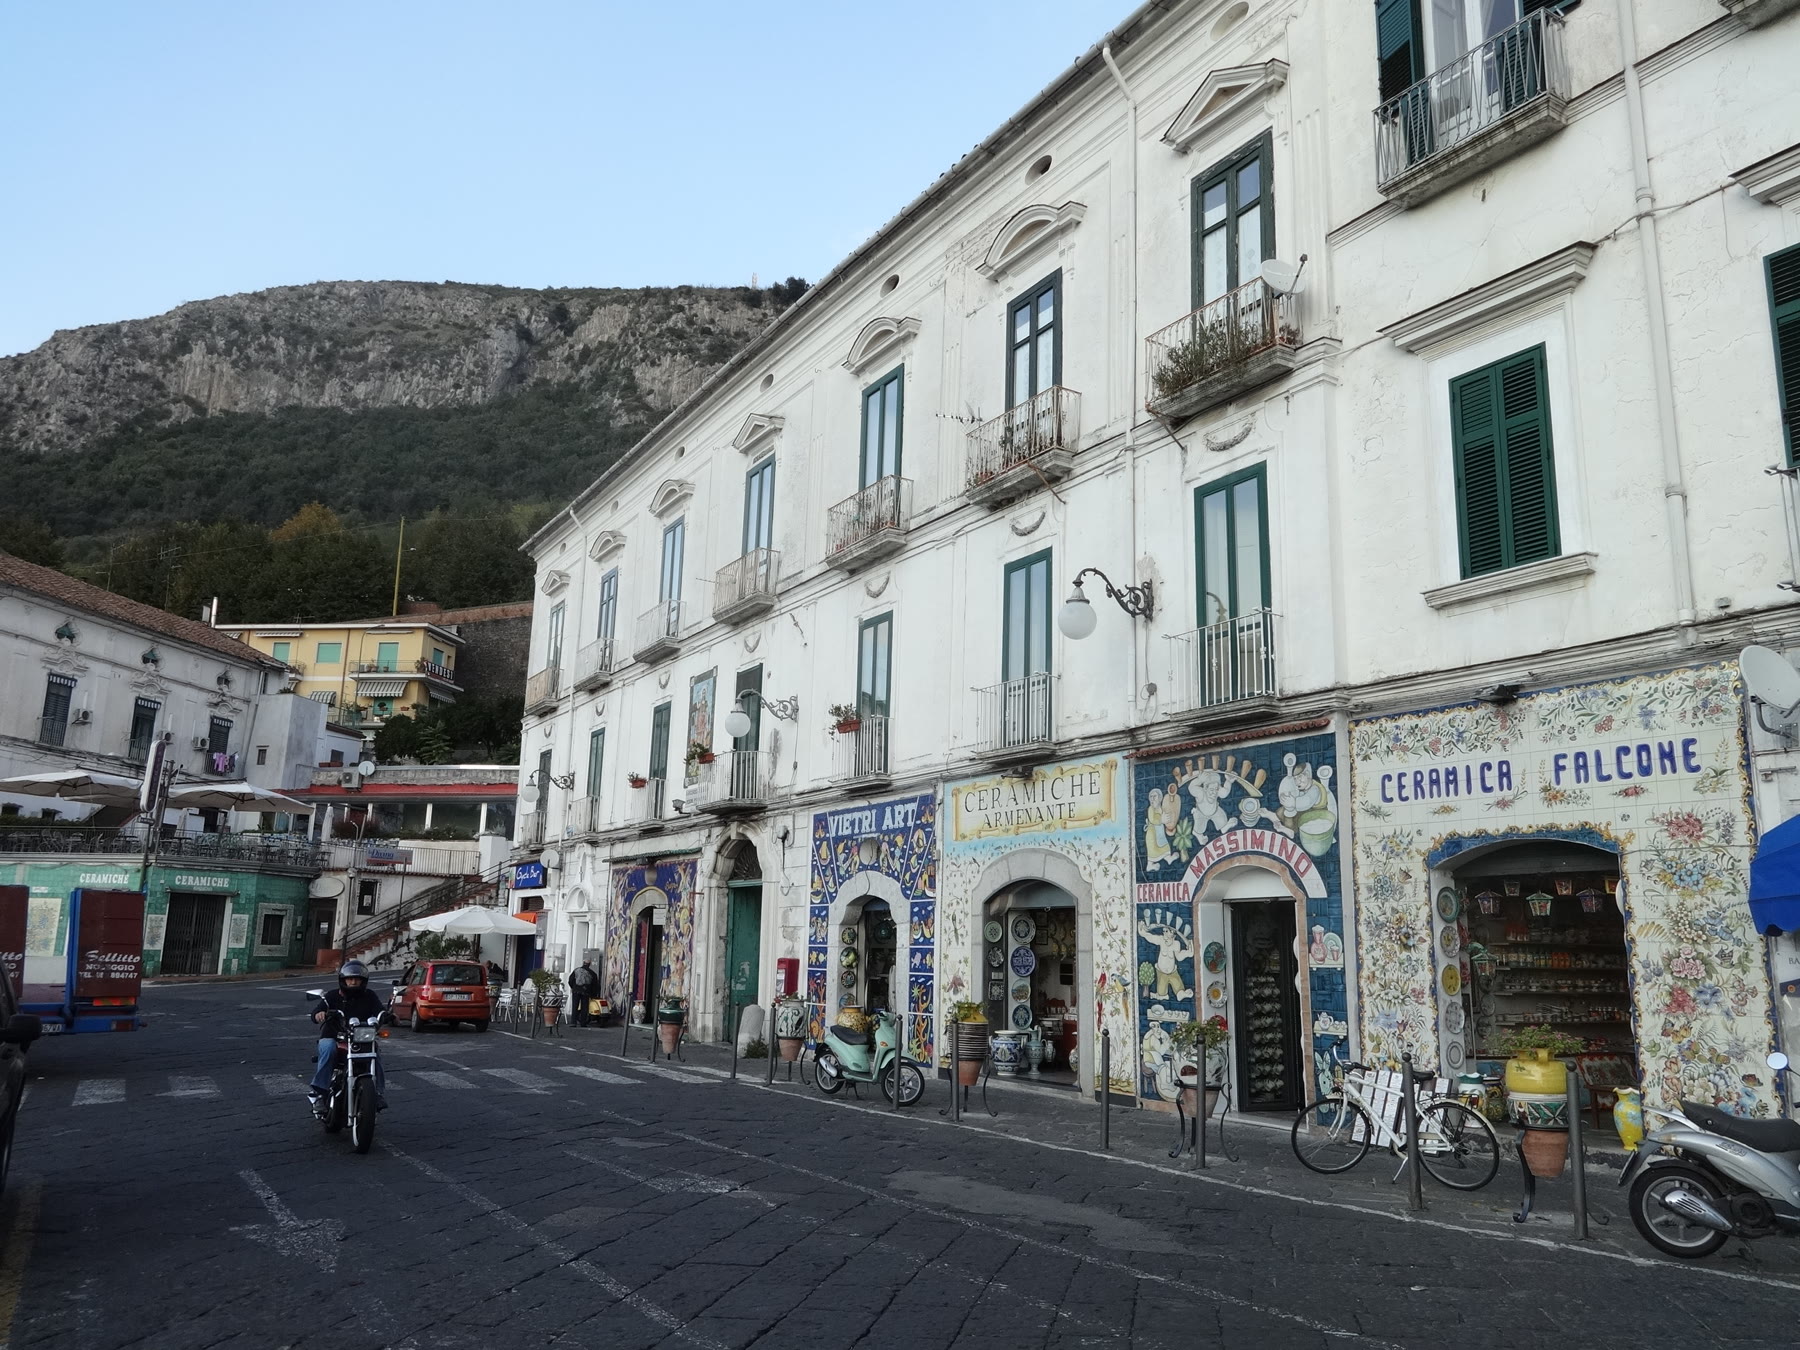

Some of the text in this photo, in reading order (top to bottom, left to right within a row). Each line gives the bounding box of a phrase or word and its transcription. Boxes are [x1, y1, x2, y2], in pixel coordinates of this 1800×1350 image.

[1381, 737, 1701, 803] CERAMICA FALCONE
[965, 771, 1100, 812] CERAMICHE
[829, 802, 918, 837] VIETRI ART
[982, 802, 1076, 828] ARMENANTE
[1190, 829, 1312, 878] MASSIMINO
[79, 873, 129, 884] CERAMICHE
[175, 875, 230, 887] CERAMICHE
[1137, 882, 1190, 902] CERAMICA
[85, 950, 141, 963] Sellitto
[85, 963, 135, 971] NOGGIO
